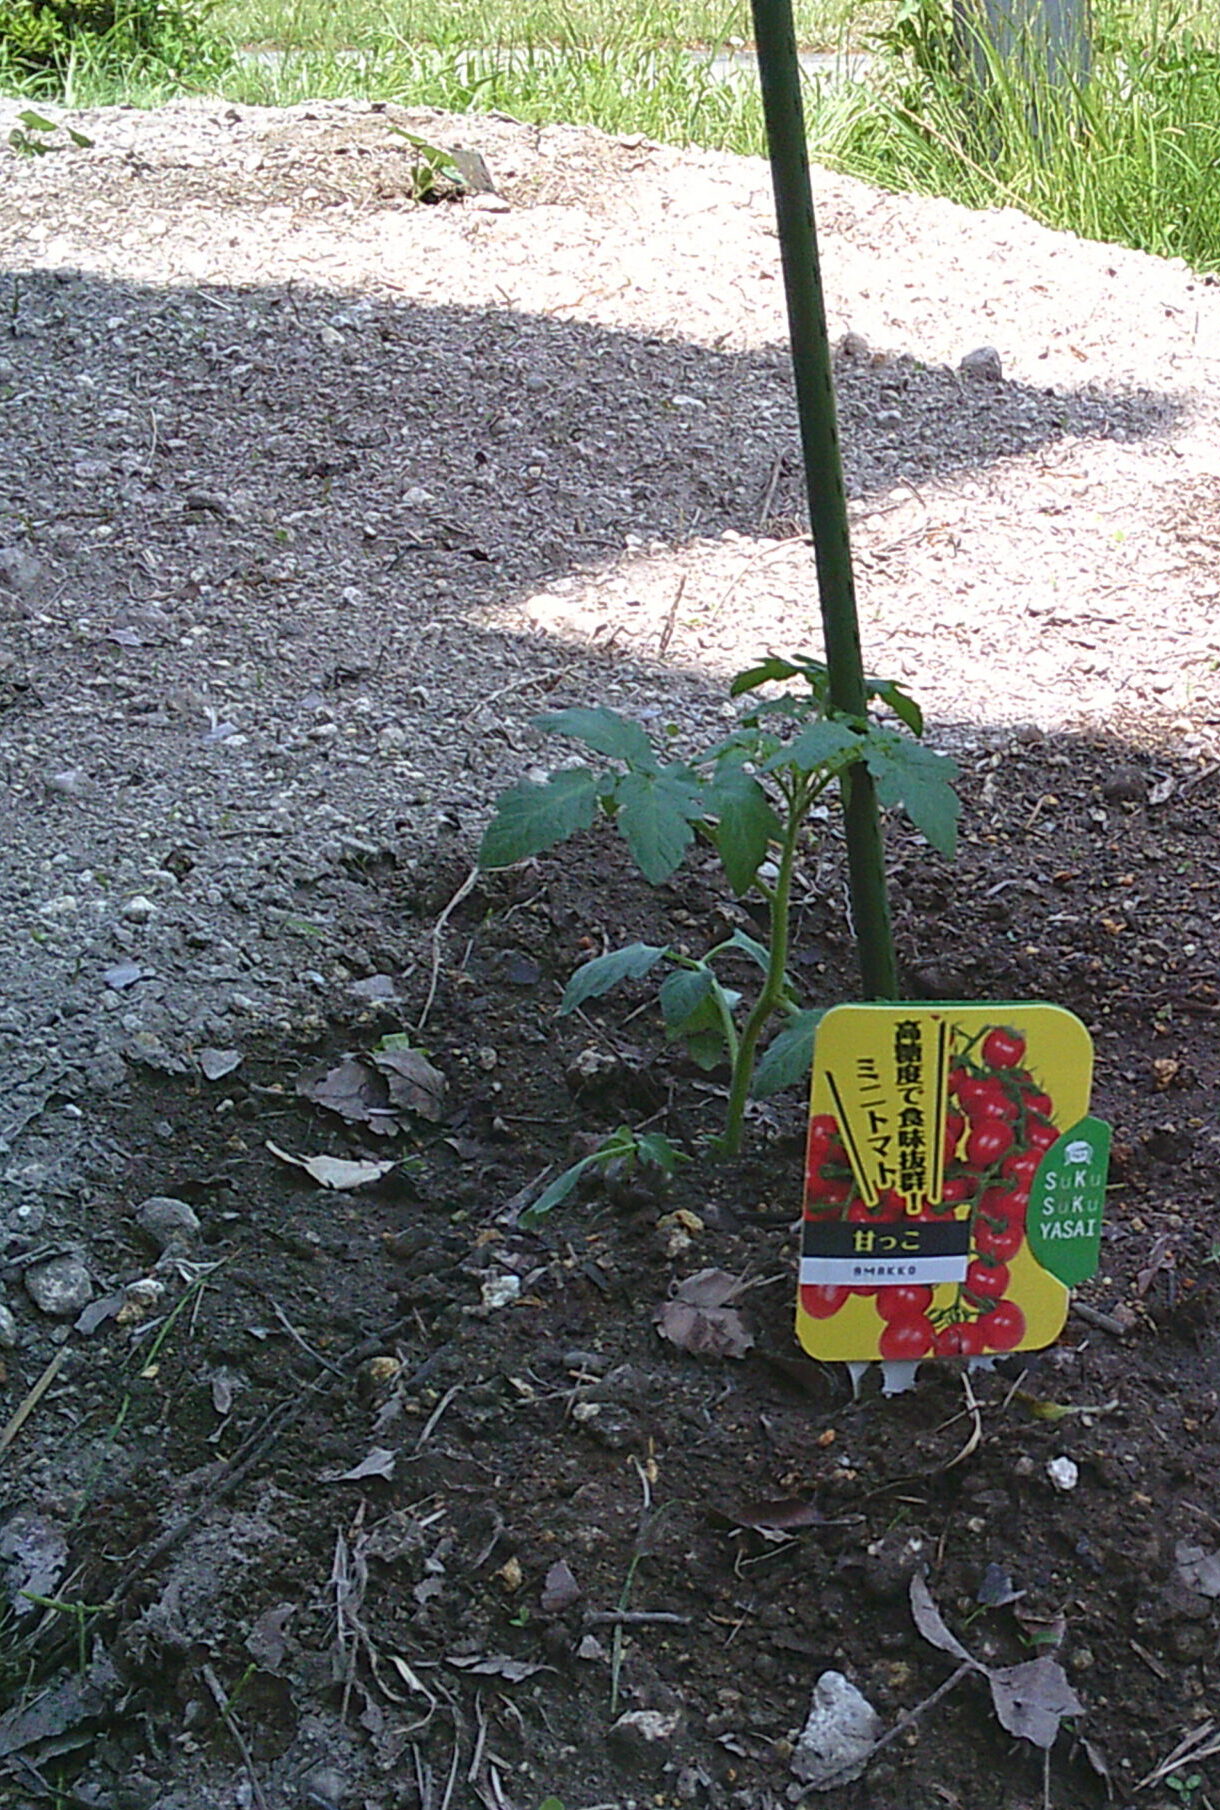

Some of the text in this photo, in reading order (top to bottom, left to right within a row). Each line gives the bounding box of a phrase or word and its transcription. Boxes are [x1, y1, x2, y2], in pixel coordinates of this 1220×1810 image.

[856, 1058, 897, 1186] ミニトマト
[852, 1229, 920, 1252] 甘っこ
[1040, 1218, 1096, 1240] YASAI
